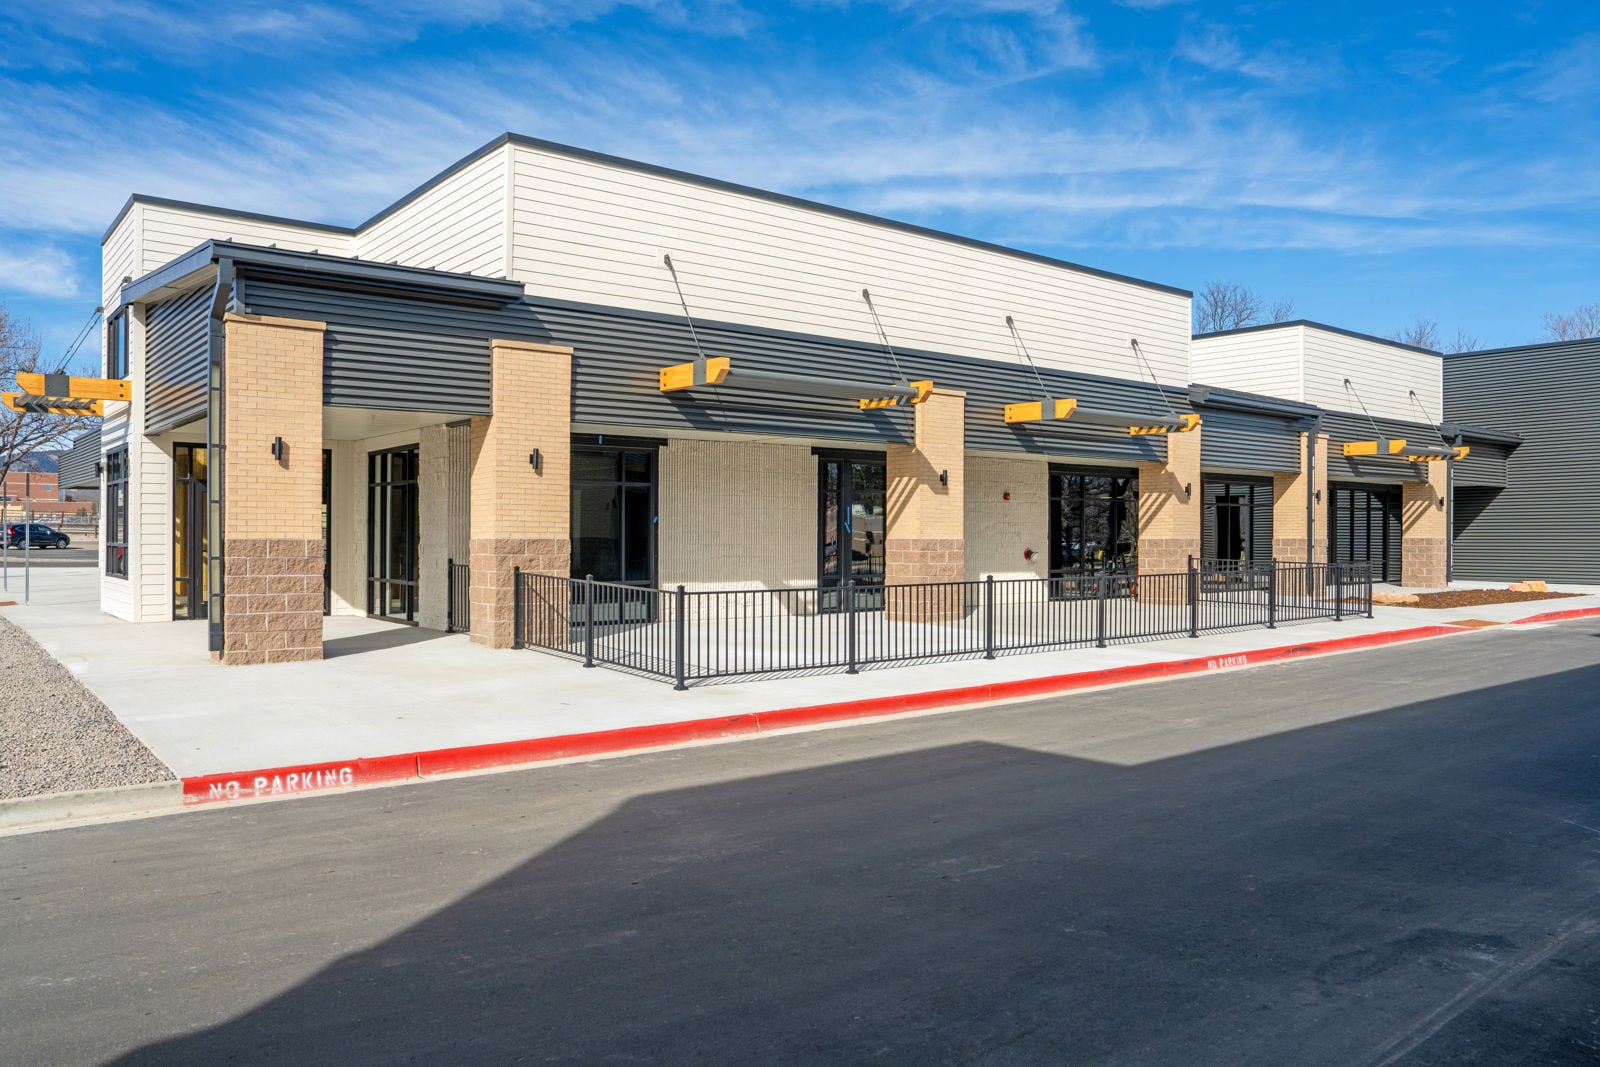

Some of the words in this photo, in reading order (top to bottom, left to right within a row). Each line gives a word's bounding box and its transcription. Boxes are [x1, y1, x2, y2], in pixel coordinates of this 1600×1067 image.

[1207, 659, 1217, 670] NO
[1219, 655, 1247, 669] PARKING
[208, 781, 240, 799] NO
[254, 767, 353, 796] PARKING
